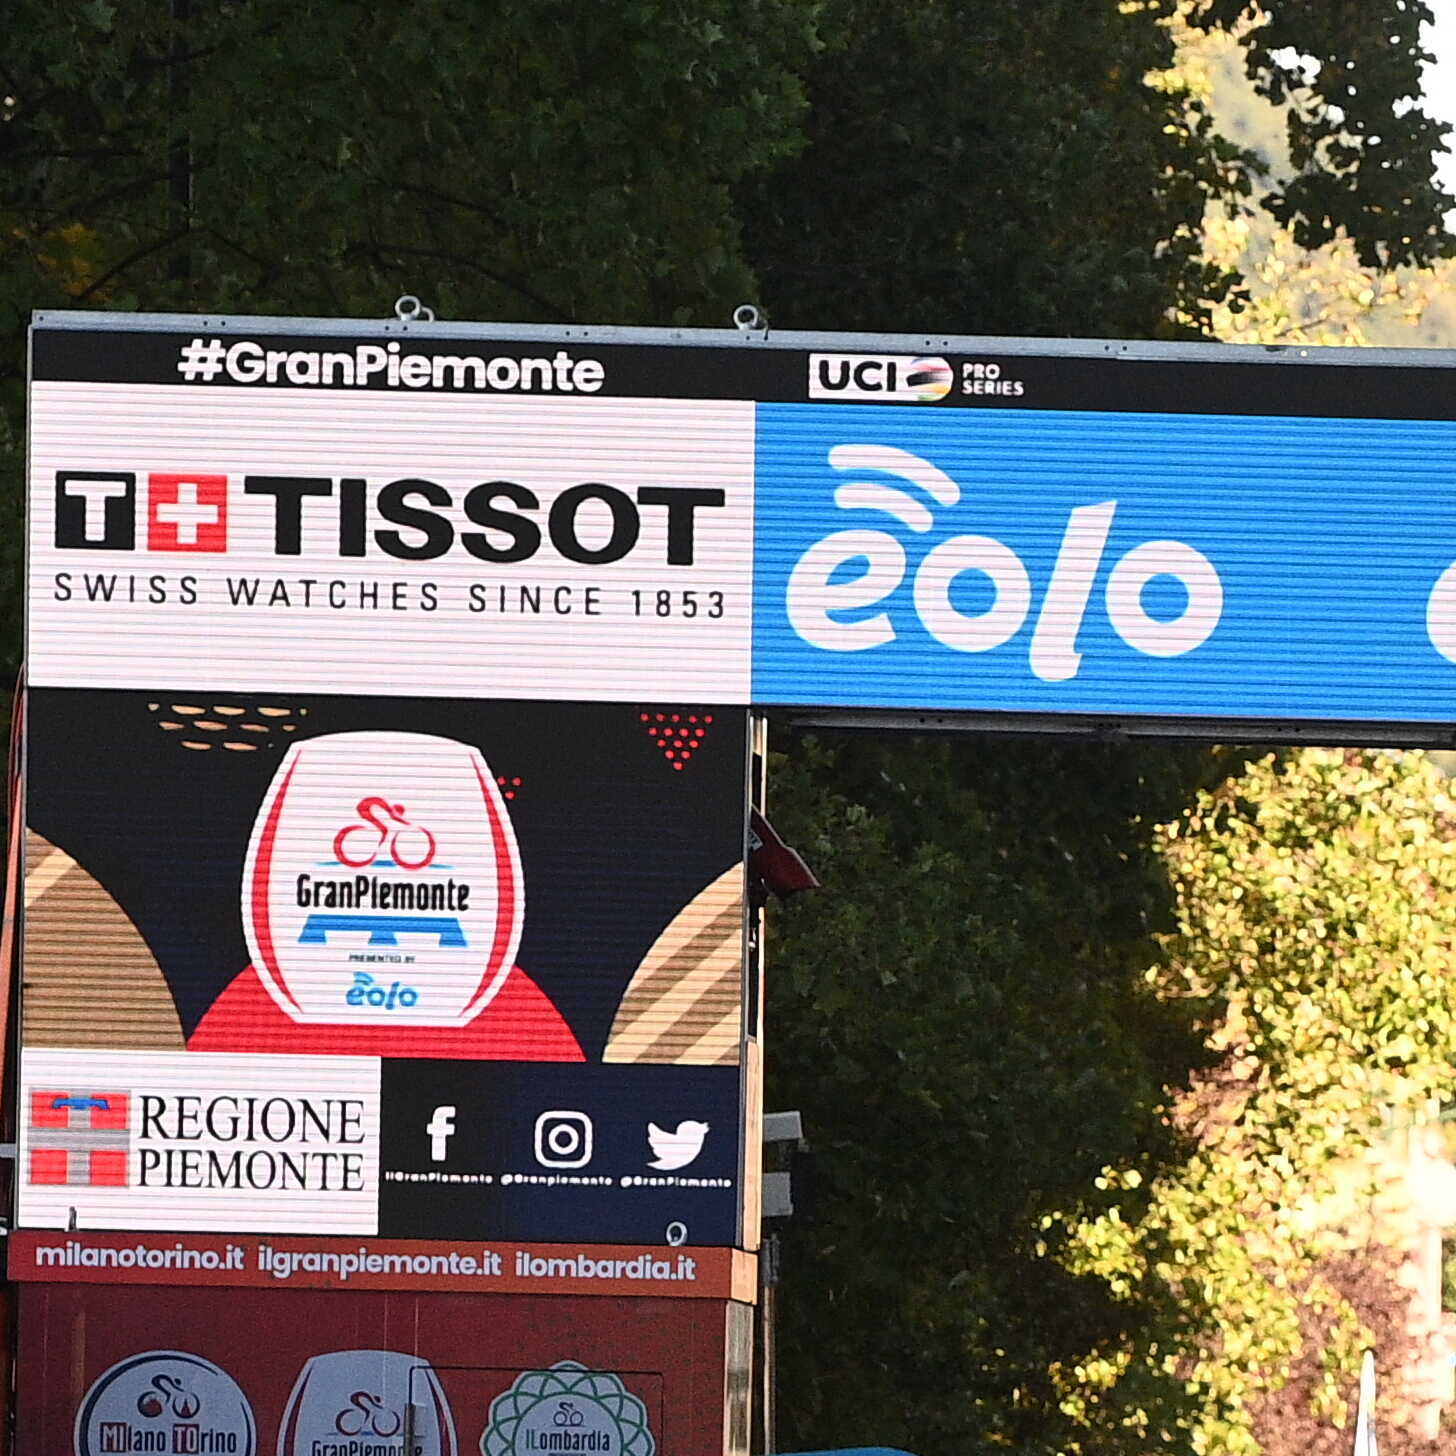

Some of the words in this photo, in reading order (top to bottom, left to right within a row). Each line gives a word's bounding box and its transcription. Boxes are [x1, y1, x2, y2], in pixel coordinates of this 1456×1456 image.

[178, 338, 605, 393] #GranPiemonte
[818, 361, 897, 392] UCI
[963, 364, 1000, 380] PRO
[963, 379, 1024, 397] SERIES
[244, 476, 725, 565] TISSOT
[54, 574, 199, 604] SWISS
[226, 578, 438, 611] WATCHES
[469, 584, 600, 616] SINCE
[631, 590, 726, 619] 1853
[786, 500, 1223, 682] eolo
[297, 874, 470, 912] GranPiemonte
[346, 976, 418, 1011] eolo
[139, 1095, 365, 1145] REGIONE
[137, 1151, 365, 1191] PIEMONTE
[36, 1243, 244, 1271] milanotorino.it
[258, 1247, 502, 1280] ilgranpiemonte.it
[515, 1251, 695, 1281] ilombardia.it
